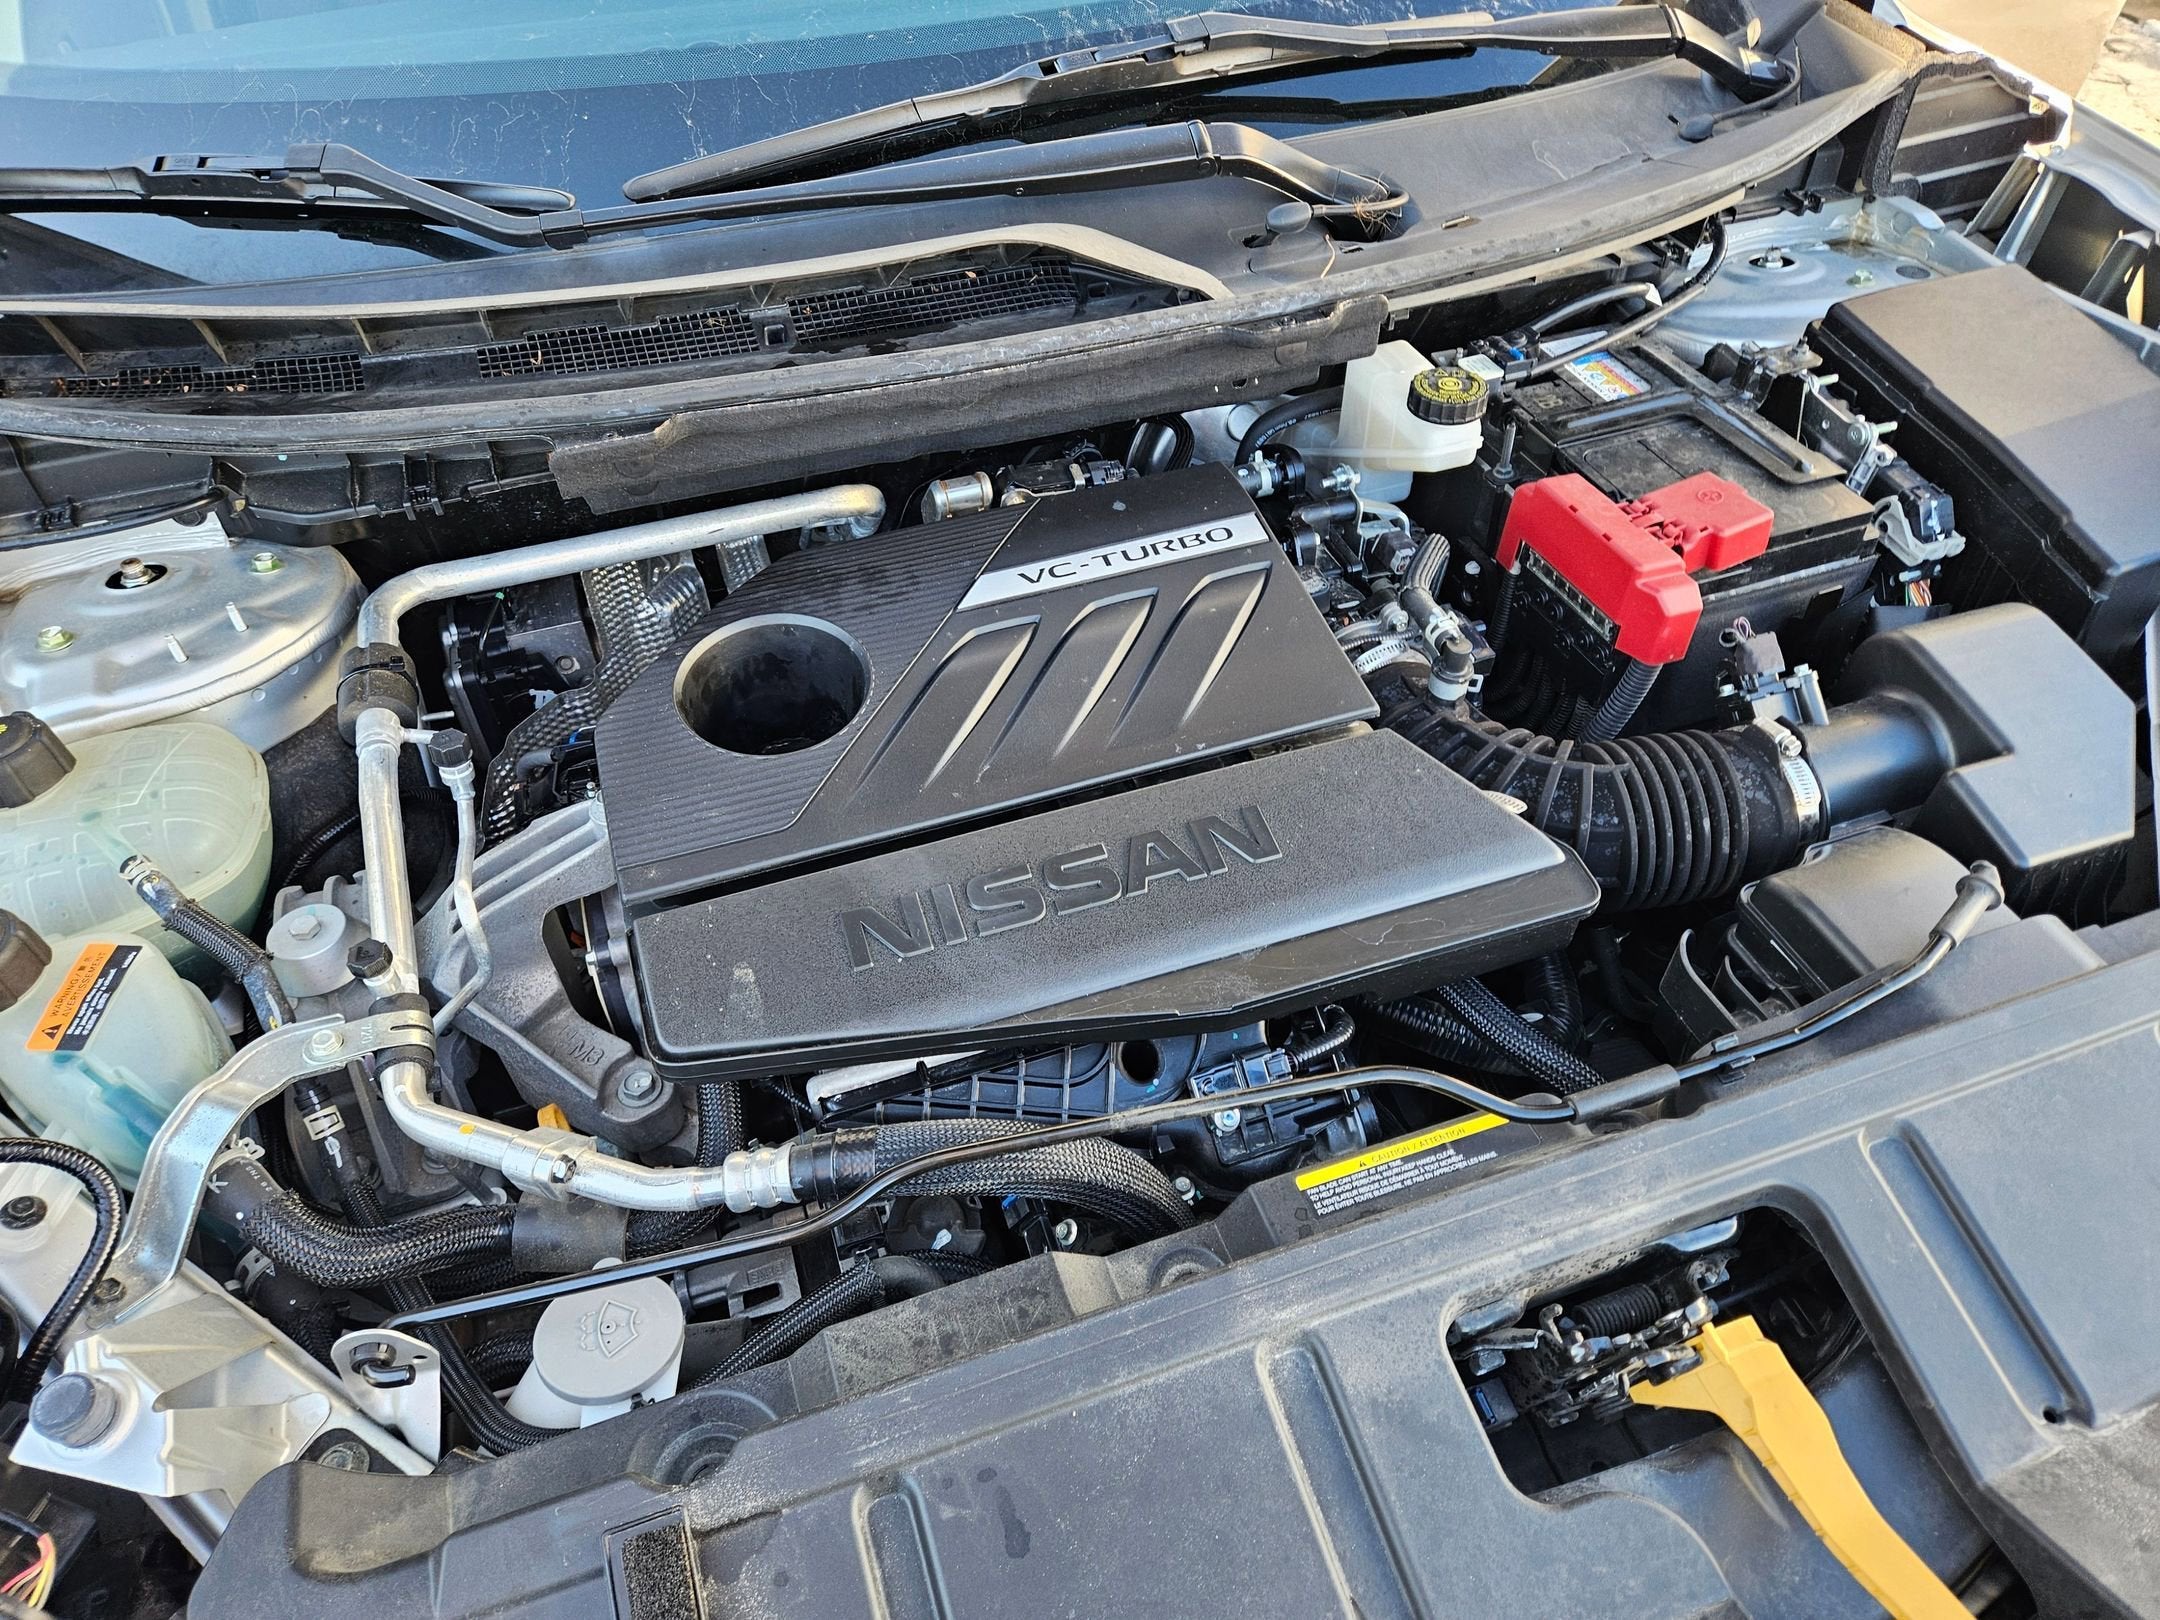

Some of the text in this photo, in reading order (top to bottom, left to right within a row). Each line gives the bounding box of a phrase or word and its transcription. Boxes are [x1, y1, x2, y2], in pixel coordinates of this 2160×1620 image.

[1018, 527, 1234, 584] VC-TURBO
[840, 804, 1283, 972] NISSAN
[62, 952, 106, 1018] AVERTISSEMENT
[1371, 1145, 1411, 1163] CAUTION
[1419, 1127, 1466, 1148] ATTENTION
[1307, 1187, 1320, 1196] FAN
[1319, 1181, 1338, 1192] BLADE
[1351, 1170, 1369, 1181] START
[1317, 1205, 1335, 1216] POUR
[1354, 1192, 1375, 1204] TOUTE
[1412, 1175, 1425, 1184] PAS
[1433, 1160, 1468, 1177] APPROCHER
[1467, 1156, 1479, 1166] LES
[1319, 1189, 1335, 1200] HELP
[1335, 1182, 1353, 1194] AVOID
[1352, 1174, 1383, 1188] PERSONAL
[1321, 1189, 1359, 1207] VENTILATEUR
[1424, 1161, 1439, 1172] TOUT
